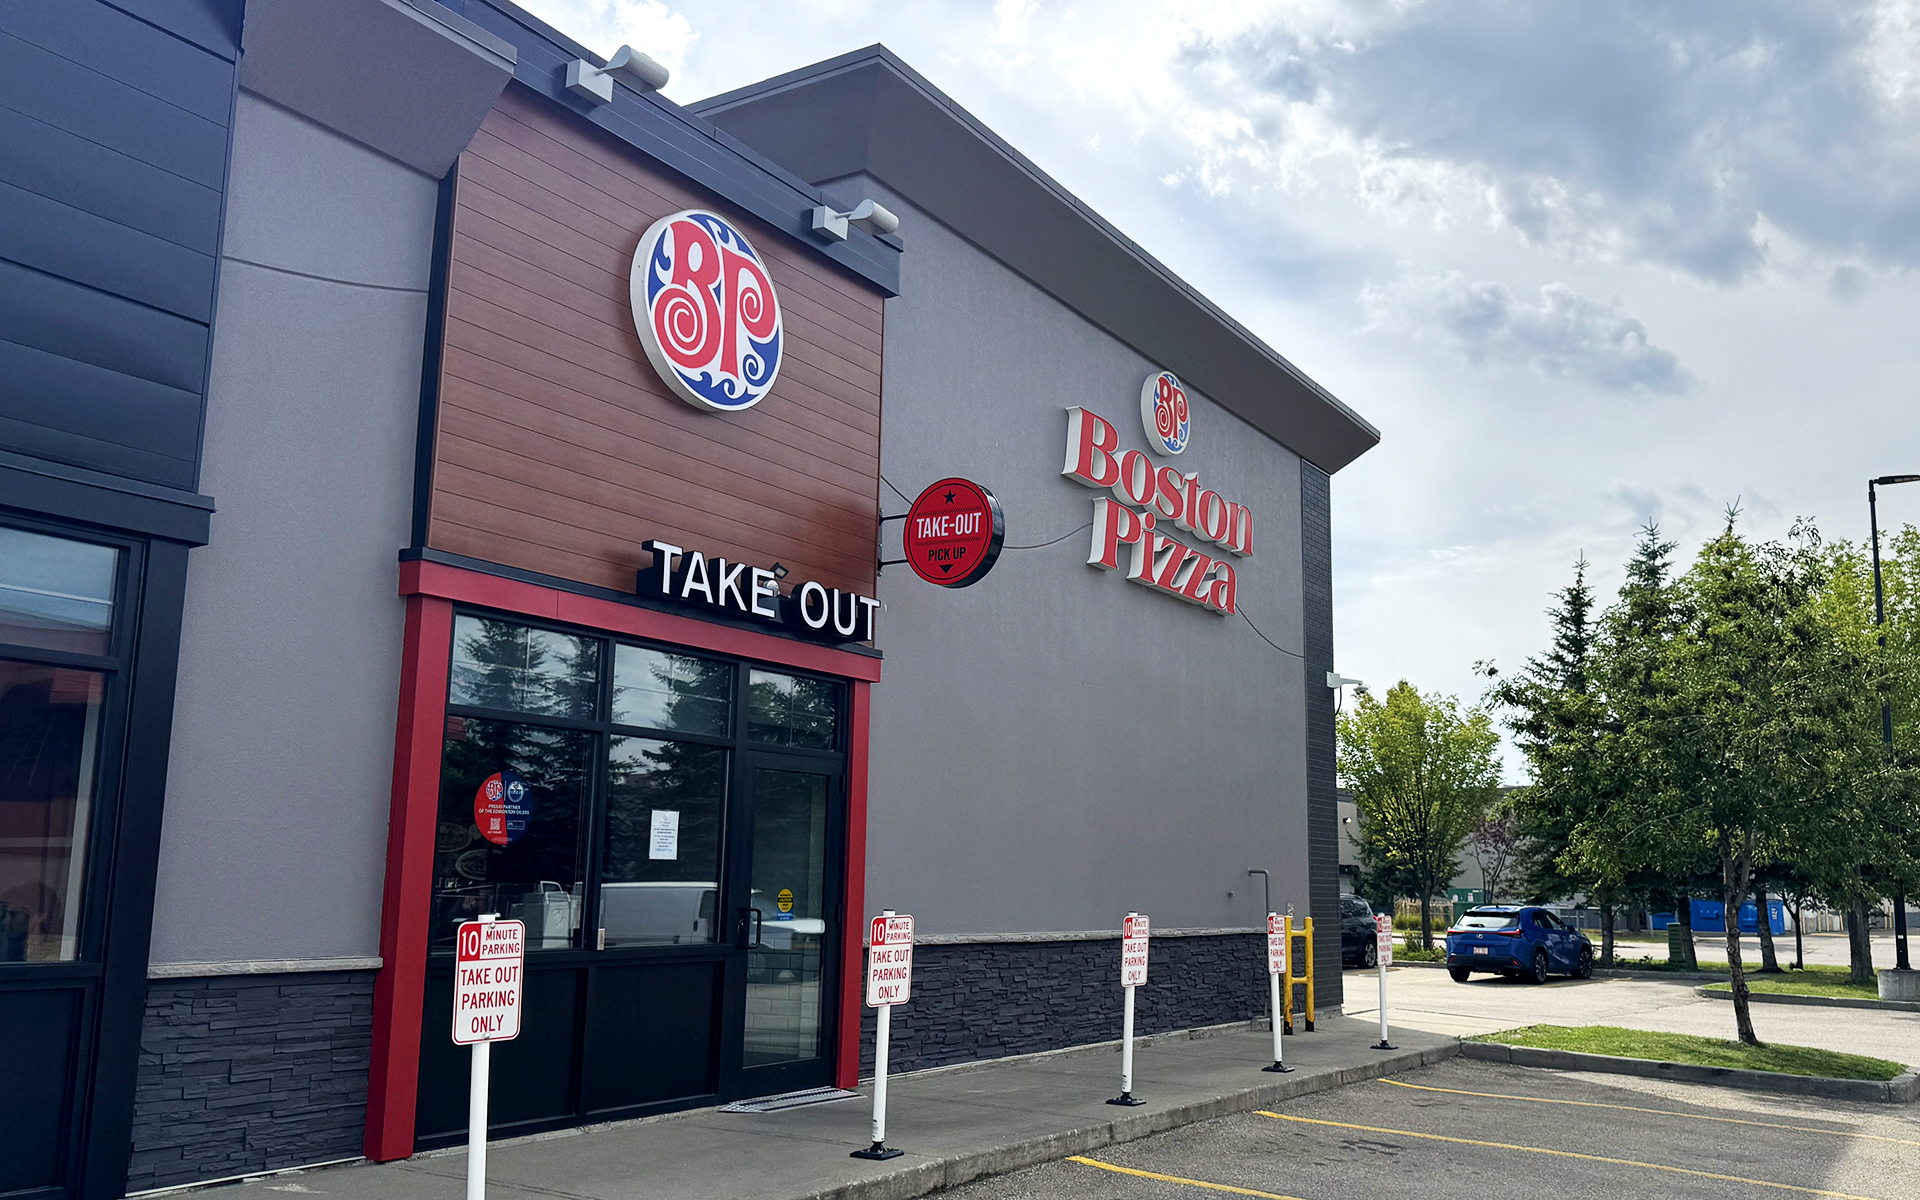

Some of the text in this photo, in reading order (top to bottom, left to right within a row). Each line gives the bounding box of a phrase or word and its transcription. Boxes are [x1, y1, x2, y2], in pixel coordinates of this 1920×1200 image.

[654, 220, 776, 380] BP
[1073, 406, 1253, 556] Boston
[917, 512, 982, 539] TAKE-OUT
[928, 547, 966, 561] PICK UP
[1099, 497, 1237, 615] Pizza
[652, 539, 881, 641] TAKE OUT
[873, 923, 884, 942] 10
[888, 921, 910, 931] MINUTE
[1124, 921, 1132, 937] 10
[486, 929, 518, 941] MINUTE
[886, 932, 911, 941] PARKING
[462, 930, 479, 957] 10
[482, 943, 520, 955] PARKING
[1125, 942, 1147, 954] TAKE OUT
[872, 949, 909, 964] TAKE OUT
[1125, 956, 1146, 967] PARKING
[461, 966, 519, 986] TAKE OUT
[872, 967, 907, 982] PARKING
[1128, 970, 1142, 981] ONLY
[878, 984, 900, 999] ONLY
[462, 990, 515, 1010] PARKING
[471, 1014, 504, 1033] ONLY
